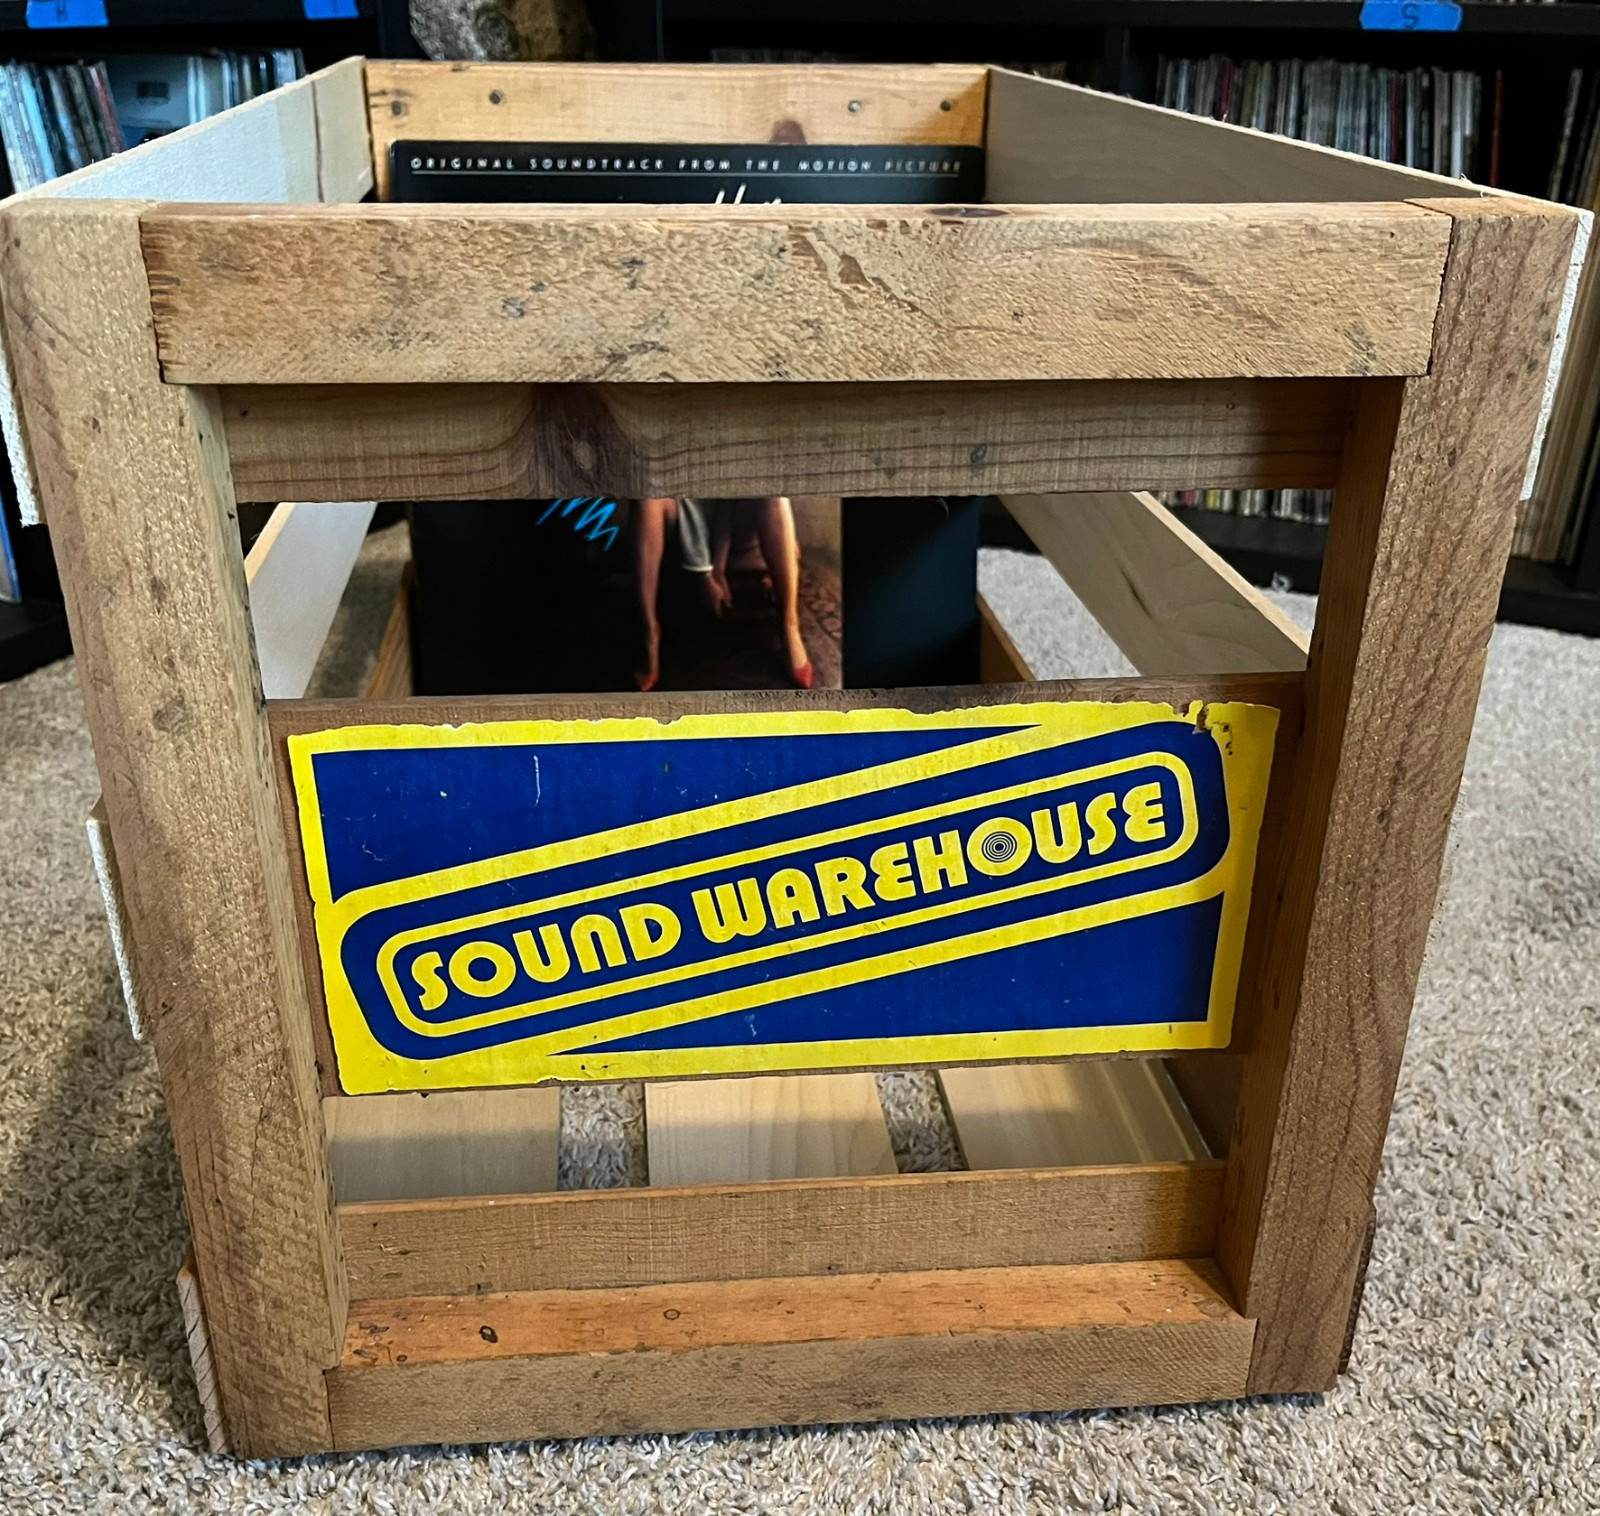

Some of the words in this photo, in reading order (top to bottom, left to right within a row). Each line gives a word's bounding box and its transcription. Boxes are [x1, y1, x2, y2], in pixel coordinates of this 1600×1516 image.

[410, 156, 514, 170] ORIGINAL
[528, 157, 664, 170] SOUNDTRACK
[678, 158, 731, 171] FROM
[745, 159, 780, 171] THE
[797, 159, 872, 172] MOTION
[884, 160, 961, 172] PICTURE
[411, 902, 682, 1011] SOUND
[691, 782, 1167, 943] WAREHOUSE
